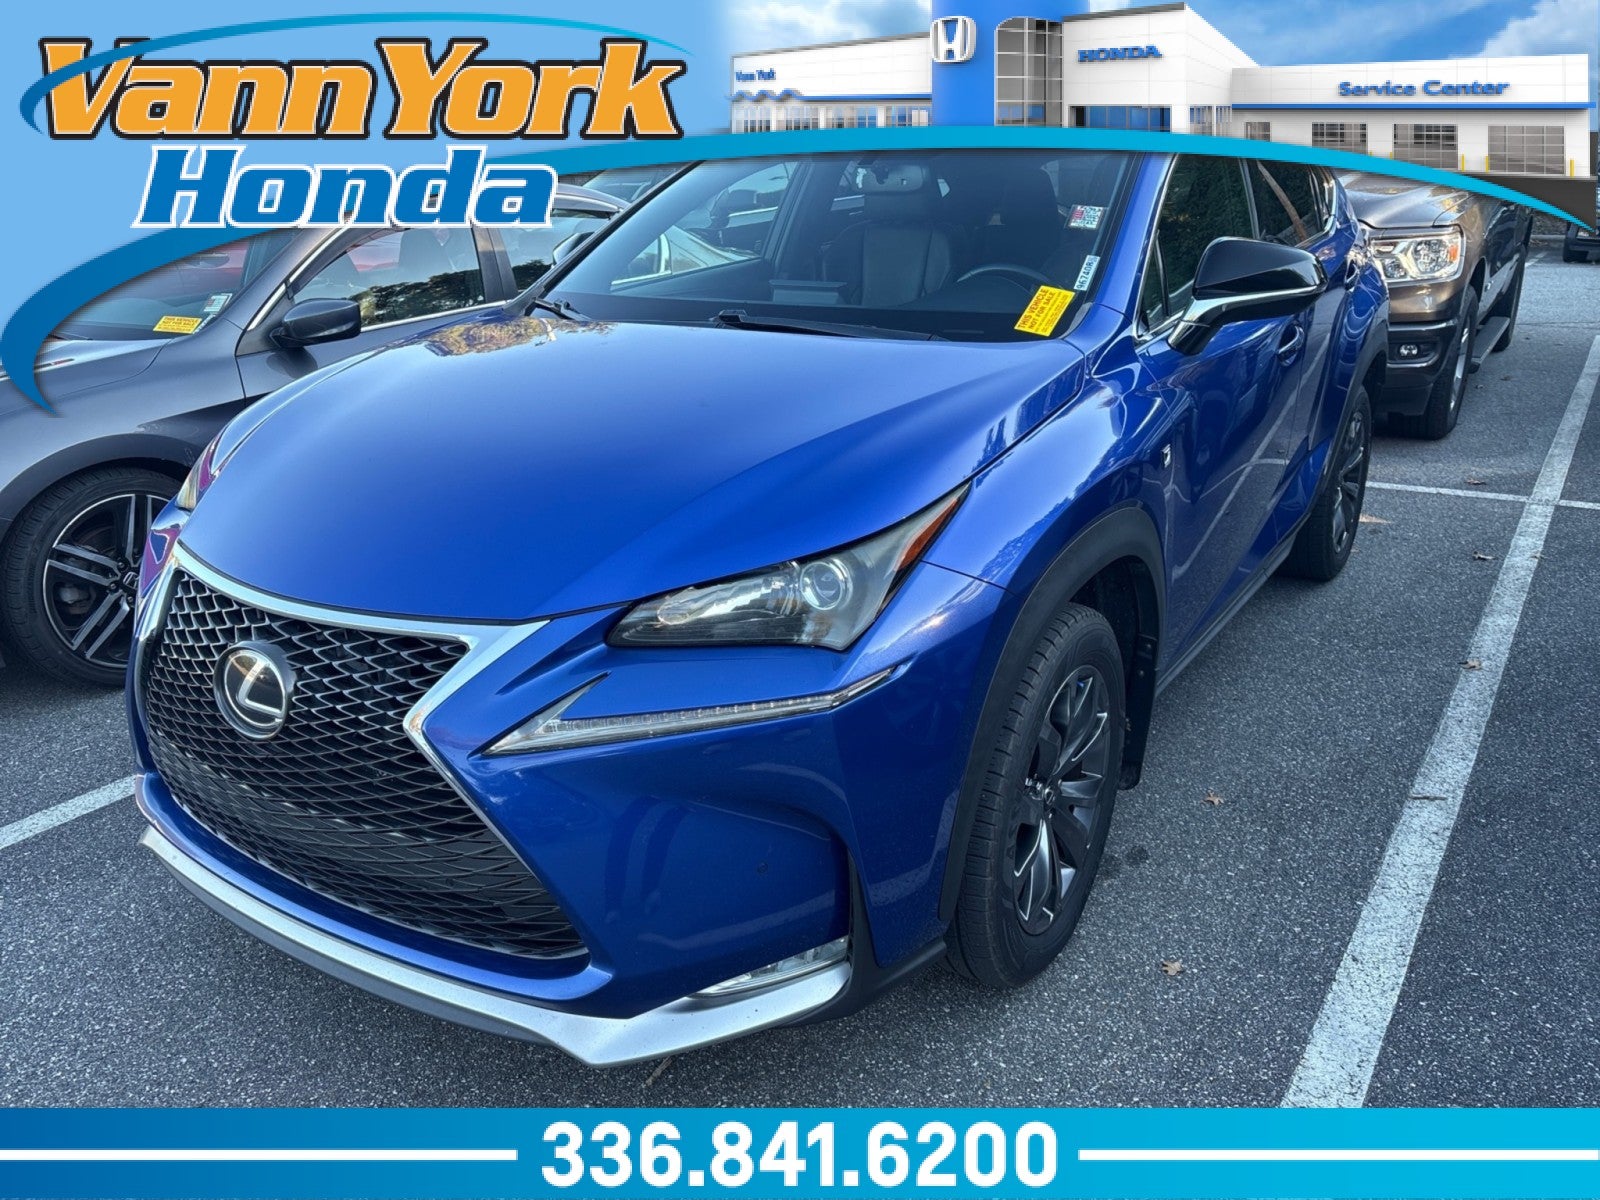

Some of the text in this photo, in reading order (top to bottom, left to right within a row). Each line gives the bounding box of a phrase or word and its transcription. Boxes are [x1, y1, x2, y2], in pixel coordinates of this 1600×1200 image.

[1017, 314, 1032, 328] THIS
[1028, 288, 1048, 313] VEHICLE
[1028, 317, 1039, 329] NOT
